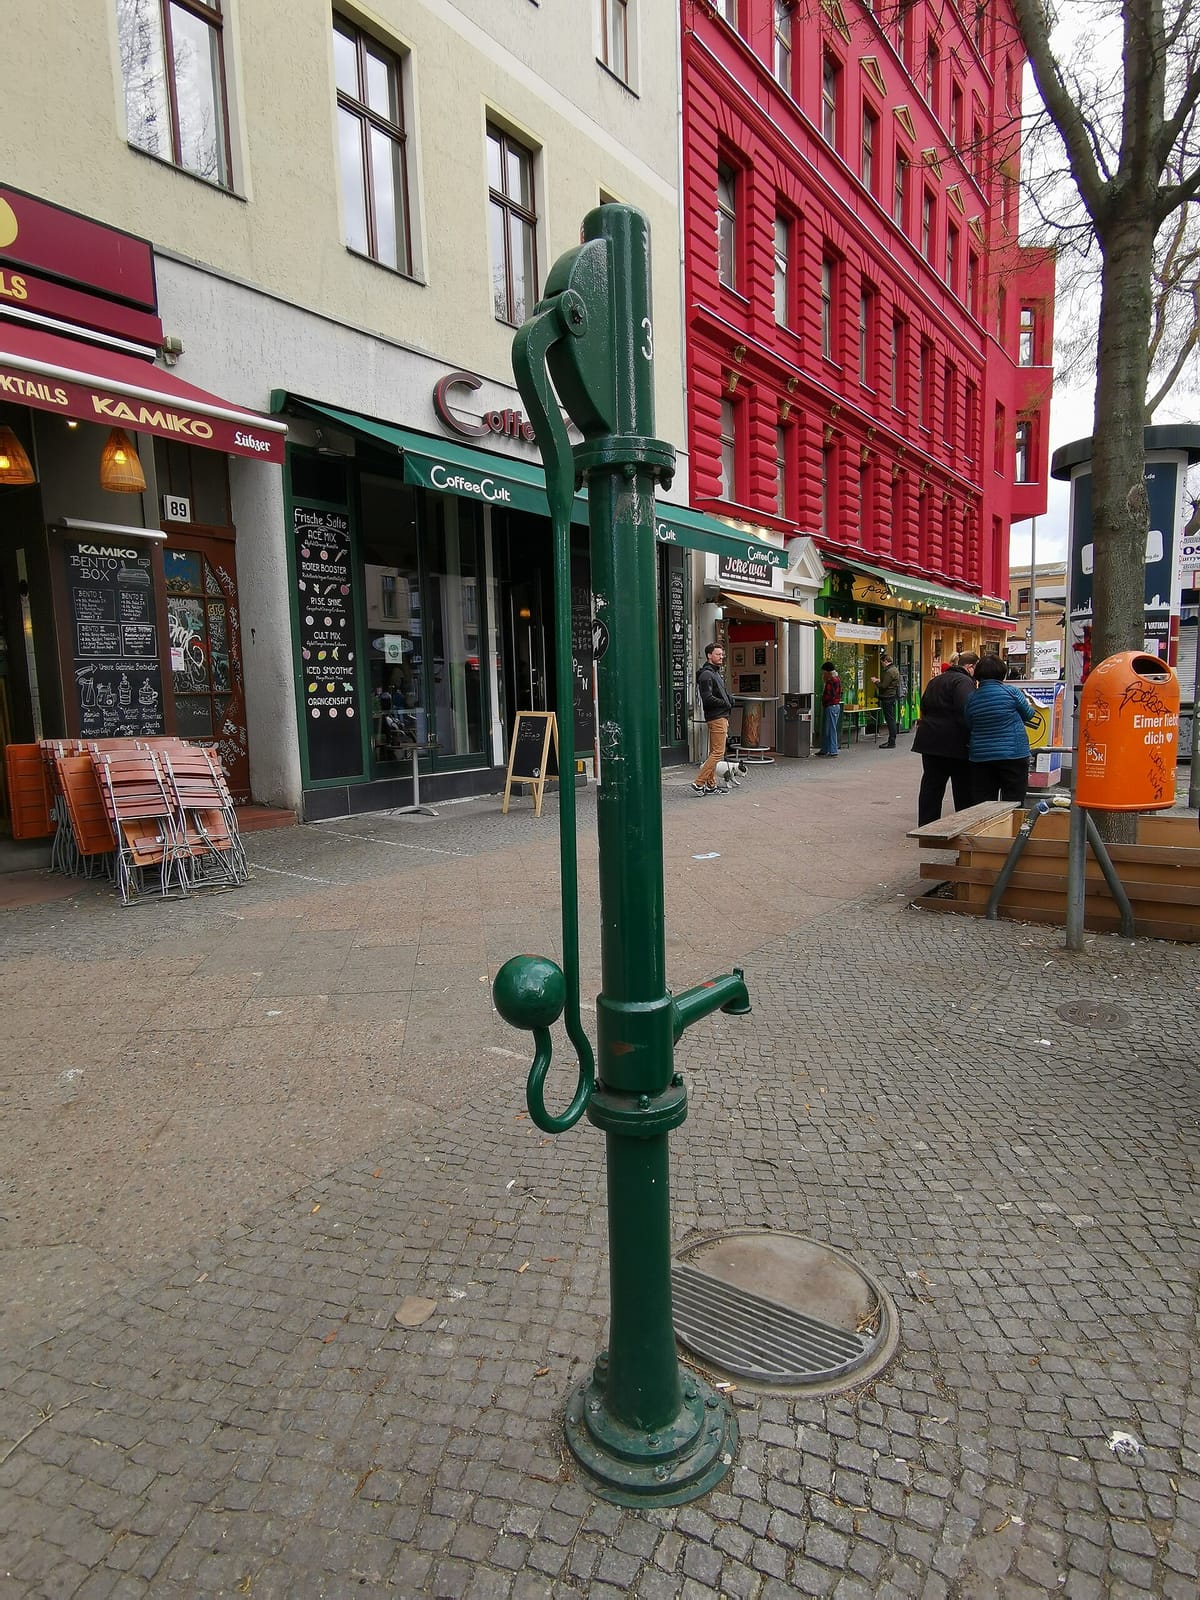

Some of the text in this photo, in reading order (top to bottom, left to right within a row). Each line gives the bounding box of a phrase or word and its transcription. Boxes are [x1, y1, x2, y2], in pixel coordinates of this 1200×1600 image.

[641, 317, 653, 361] 3
[0, 374, 271, 452] KTAILS KAMIKO Lübzer
[432, 372, 536, 442] Coffe
[170, 501, 187, 518] 89
[308, 529, 323, 541] ACE
[78, 544, 138, 559] KAMIKO
[70, 555, 118, 570] BENTO
[321, 564, 347, 575] BOOSTER
[80, 568, 110, 582] BOX
[78, 590, 98, 598] BENTO
[313, 631, 329, 640] CULT
[306, 666, 353, 675] ICED SMOOTHIE
[572, 658, 589, 690] PEN
[1134, 714, 1163, 729] Eimer
[1144, 732, 1164, 745] dich
